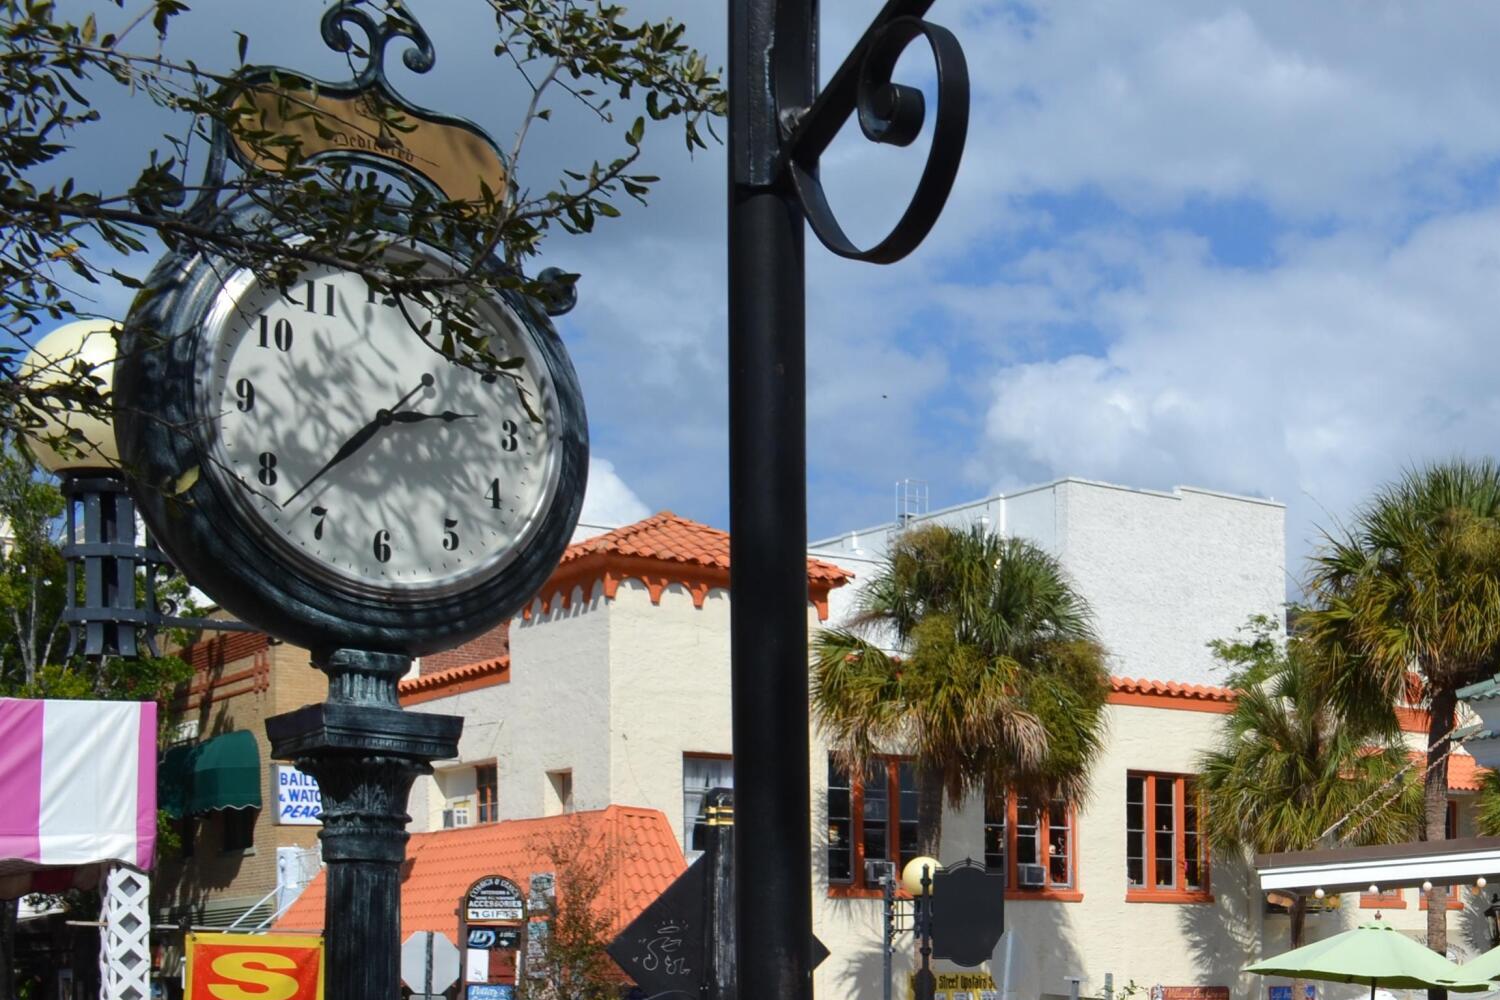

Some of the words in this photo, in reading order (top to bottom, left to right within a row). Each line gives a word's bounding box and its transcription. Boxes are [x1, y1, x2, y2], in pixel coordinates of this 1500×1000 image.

[304, 278, 336, 317] 11
[257, 313, 294, 352] 10
[235, 378, 255, 413] 9
[500, 419, 518, 452] 3
[257, 451, 278, 486] 8
[483, 477, 503, 511] 4
[311, 505, 328, 541] 7
[442, 517, 460, 551] 5
[373, 529, 392, 563] 6
